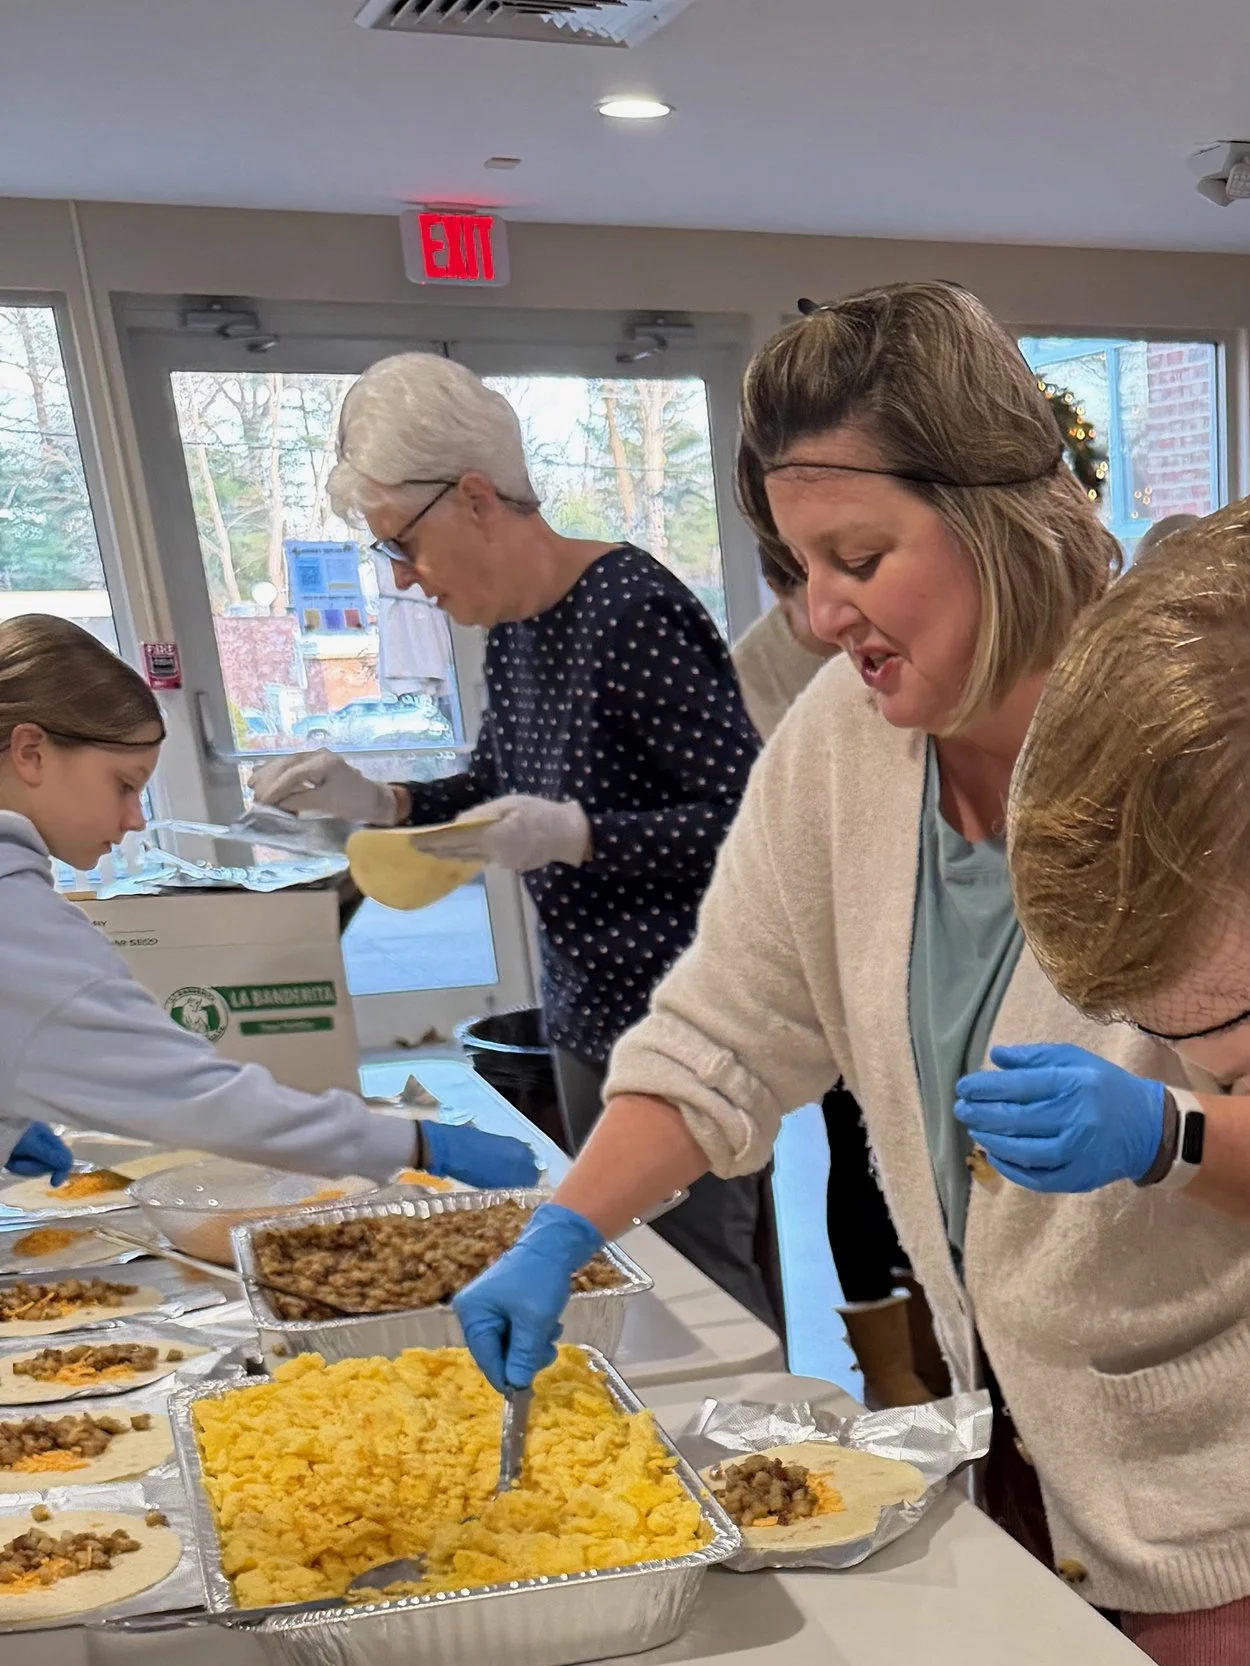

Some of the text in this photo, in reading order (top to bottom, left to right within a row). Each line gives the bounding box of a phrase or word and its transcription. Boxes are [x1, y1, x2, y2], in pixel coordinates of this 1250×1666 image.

[418, 212, 495, 281] EXIT
[229, 989, 251, 1009] LA
[251, 985, 336, 1008] BANDERITA
